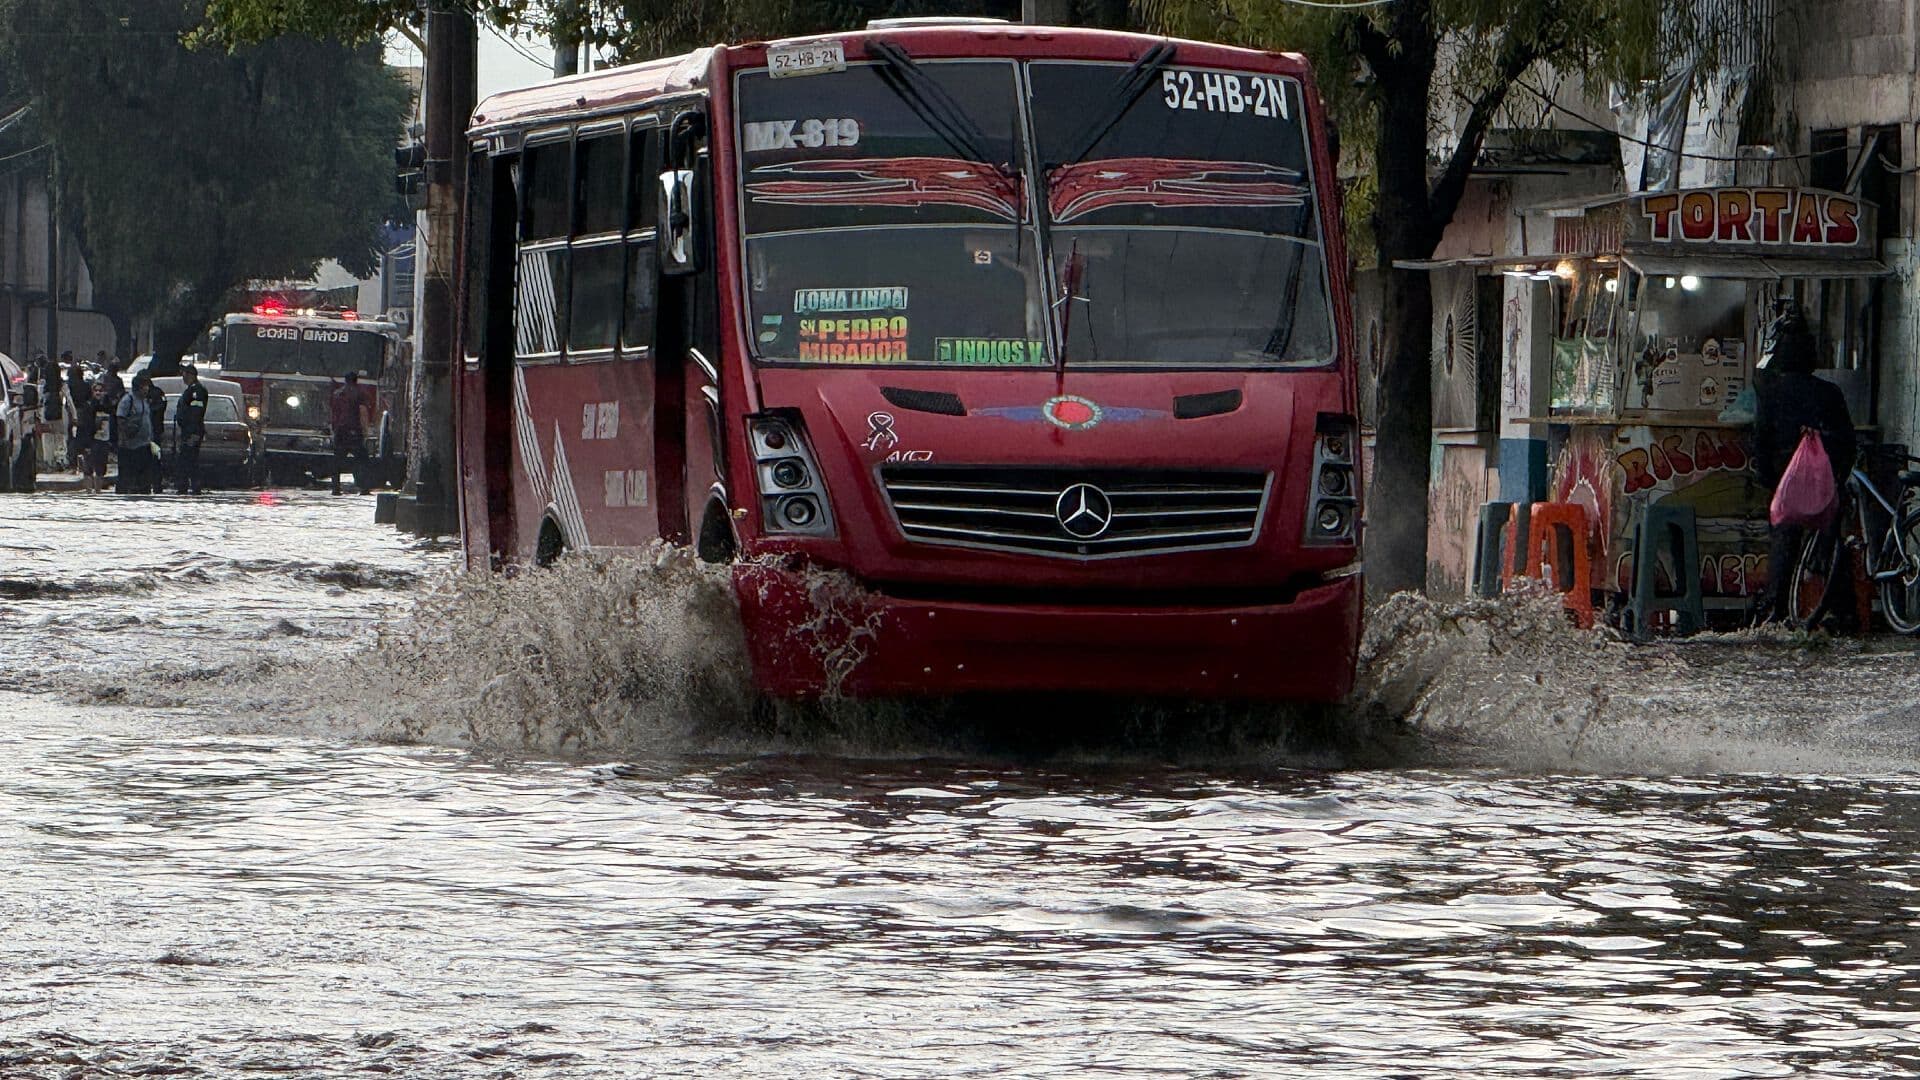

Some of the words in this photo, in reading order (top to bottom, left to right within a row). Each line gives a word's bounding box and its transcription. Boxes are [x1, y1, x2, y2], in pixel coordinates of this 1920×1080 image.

[1162, 70, 1289, 120] 52-HB-2N
[743, 118, 860, 152] MX-819
[1642, 189, 1861, 246] TORTAS
[798, 289, 848, 313] LOMA
[851, 287, 905, 310] LINDA
[818, 316, 908, 341] PEDRO
[799, 340, 908, 363] MIRADOR
[955, 339, 1025, 364] INDIOS
